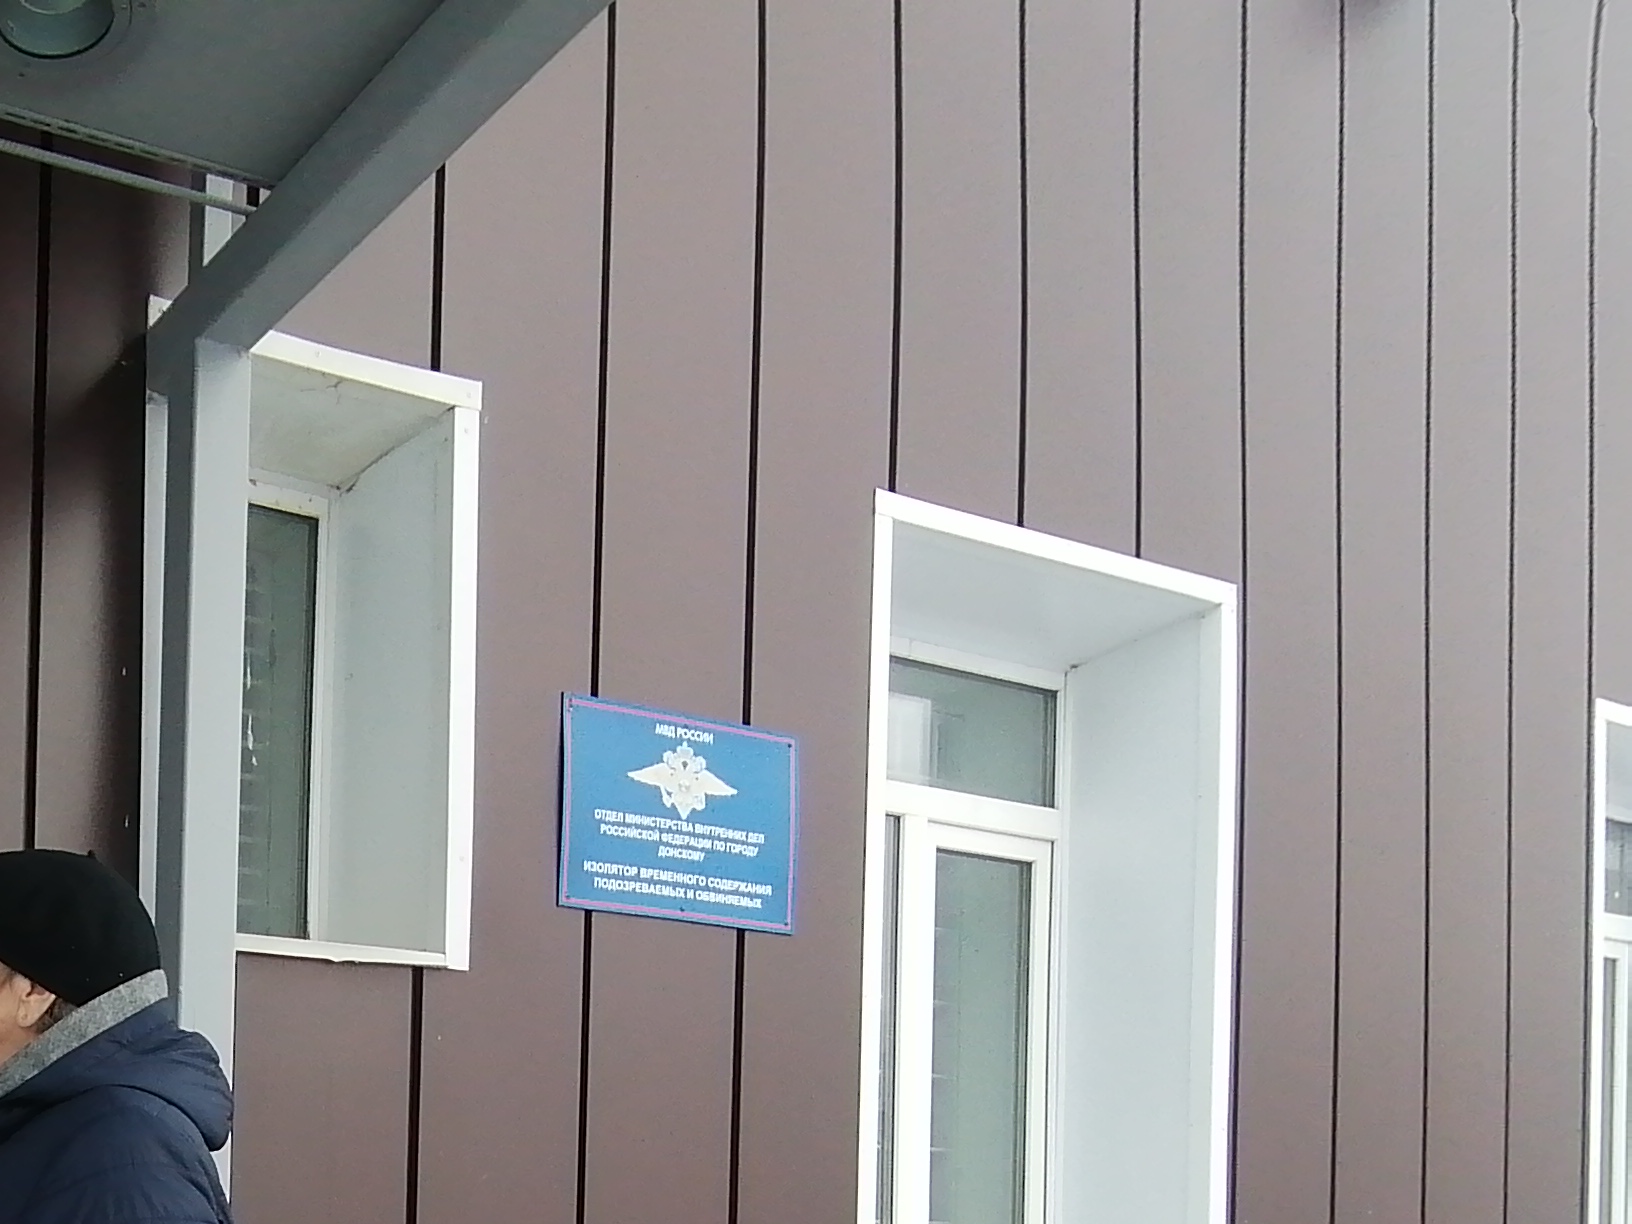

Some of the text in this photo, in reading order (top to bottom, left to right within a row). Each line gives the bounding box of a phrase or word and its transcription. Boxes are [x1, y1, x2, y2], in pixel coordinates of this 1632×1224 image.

[655, 722, 714, 746] МВД РОССИИ
[594, 808, 765, 844] ОТДЕЛ МИНИСТЕРСТВА ВНУТРЕННИХ ДЕЛ
[600, 823, 759, 858] РОССИЙСКОЙ ФЕДЕРАЦИИ ПО ГОРОДУ
[658, 845, 705, 862] ДОНСКОМУ
[583, 860, 773, 896] ИЗОЛЯТОР ВРЕМЕННОГО СОДЕРЖАНИЯ
[593, 876, 763, 908] ПОДОЗРЕВАЕМЫХ И ОБВИНЯЕМЫХ
